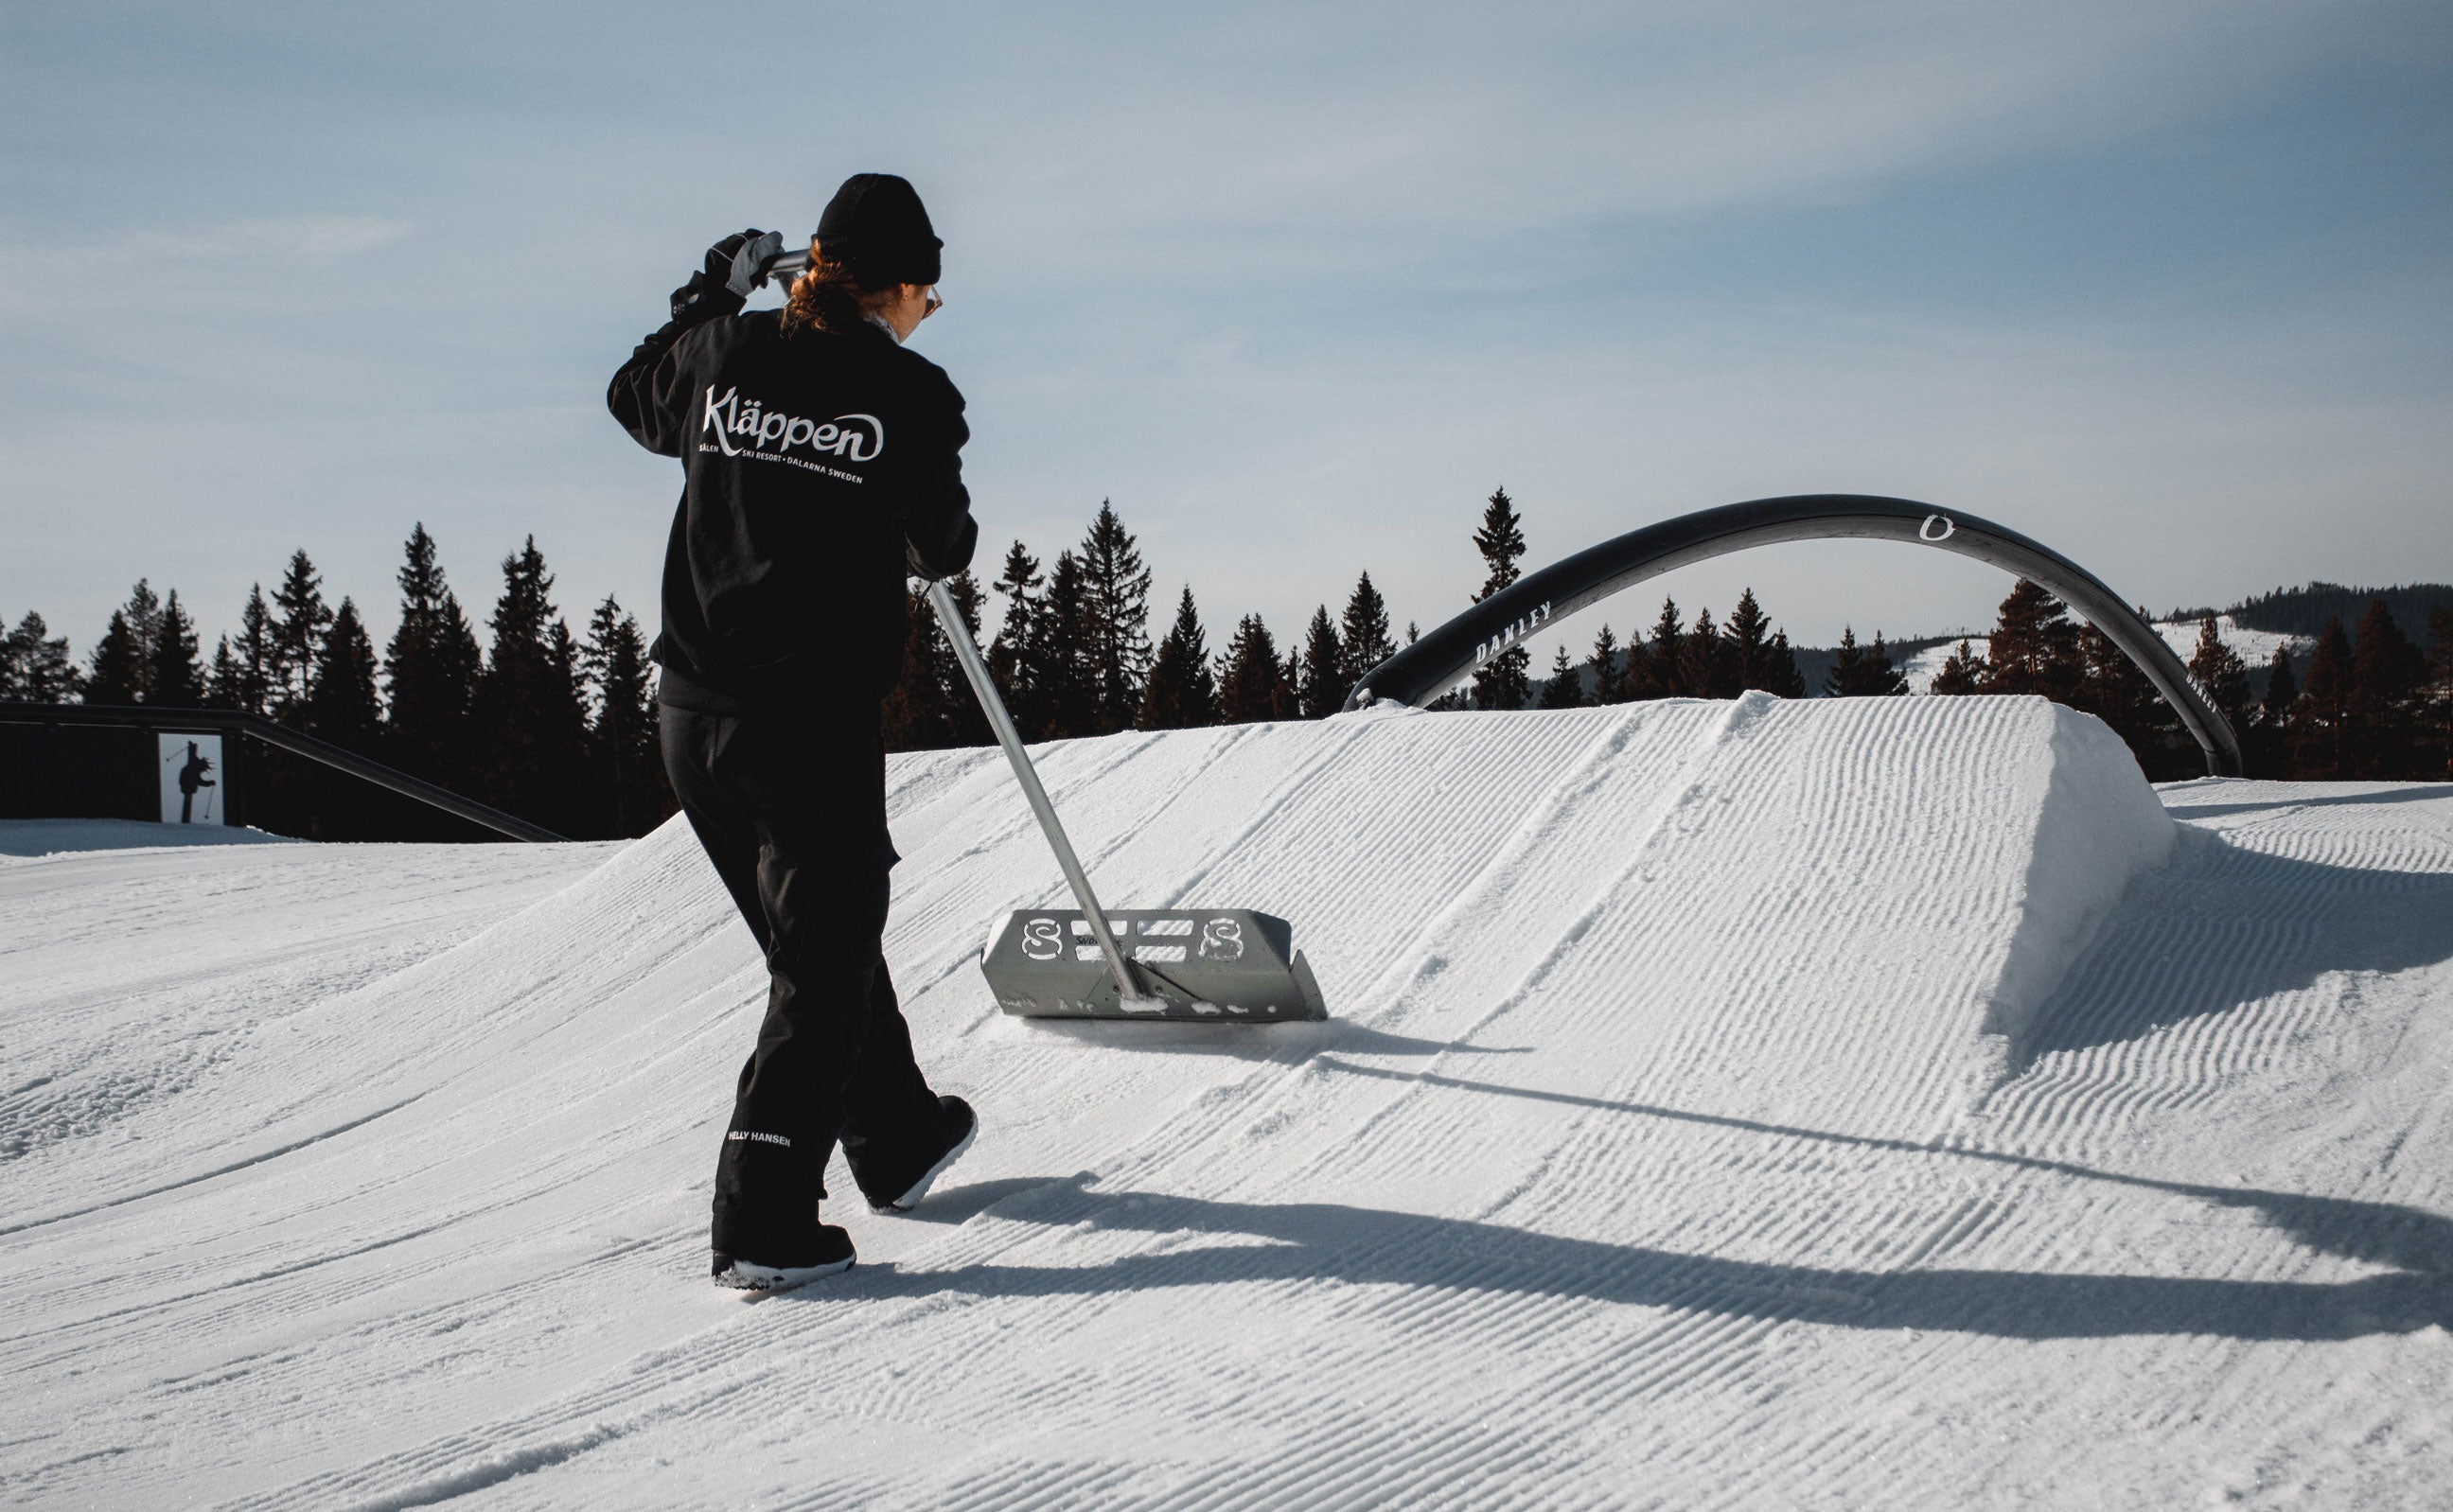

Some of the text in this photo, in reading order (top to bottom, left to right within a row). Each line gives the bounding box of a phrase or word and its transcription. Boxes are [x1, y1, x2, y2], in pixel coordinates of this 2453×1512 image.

[703, 383, 884, 462] Kläppen
[699, 443, 863, 483] SÅLEN SKI RESORT DALARNA SWEDEN
[1475, 600, 1551, 663] OAKLEY
[729, 1131, 790, 1147] HELLY HANSEN
